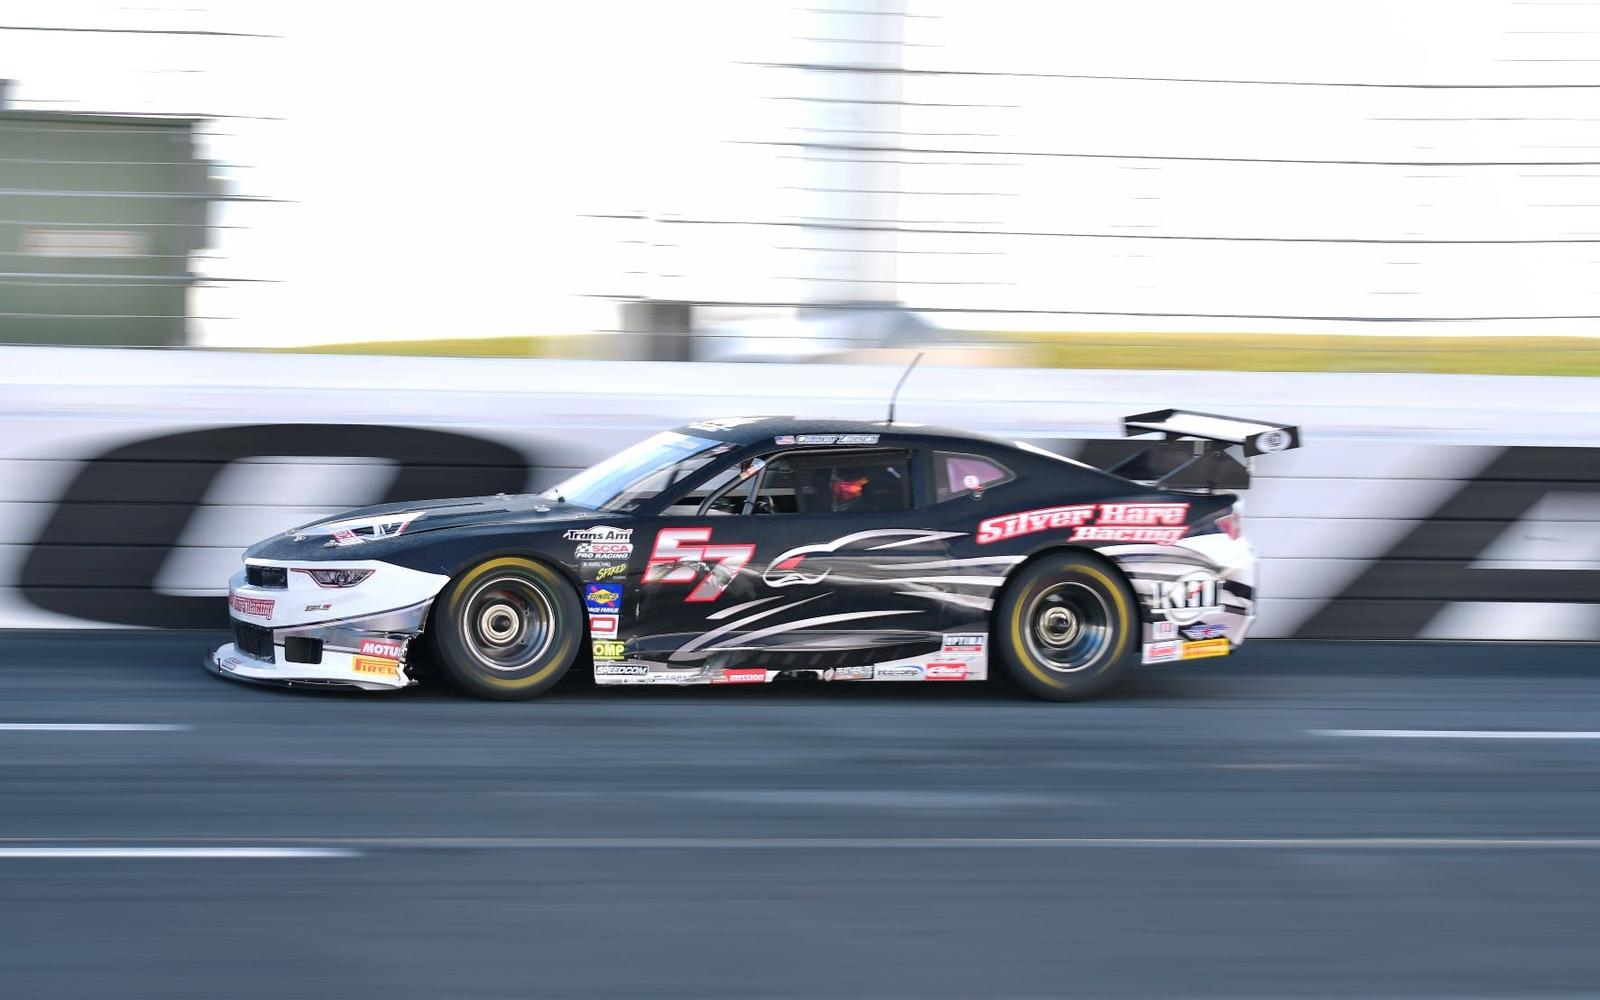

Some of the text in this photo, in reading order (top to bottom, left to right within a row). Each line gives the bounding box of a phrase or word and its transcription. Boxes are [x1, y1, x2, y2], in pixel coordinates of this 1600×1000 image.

[976, 502, 1190, 544] Silver Hare
[568, 530, 630, 540] Trans Am
[1066, 526, 1190, 546] Racing
[591, 543, 630, 552] SCCA
[641, 527, 757, 603] 57
[588, 592, 619, 601] SUNOCO
[593, 644, 625, 656] OMP
[596, 666, 648, 675] SPEEDCOM
